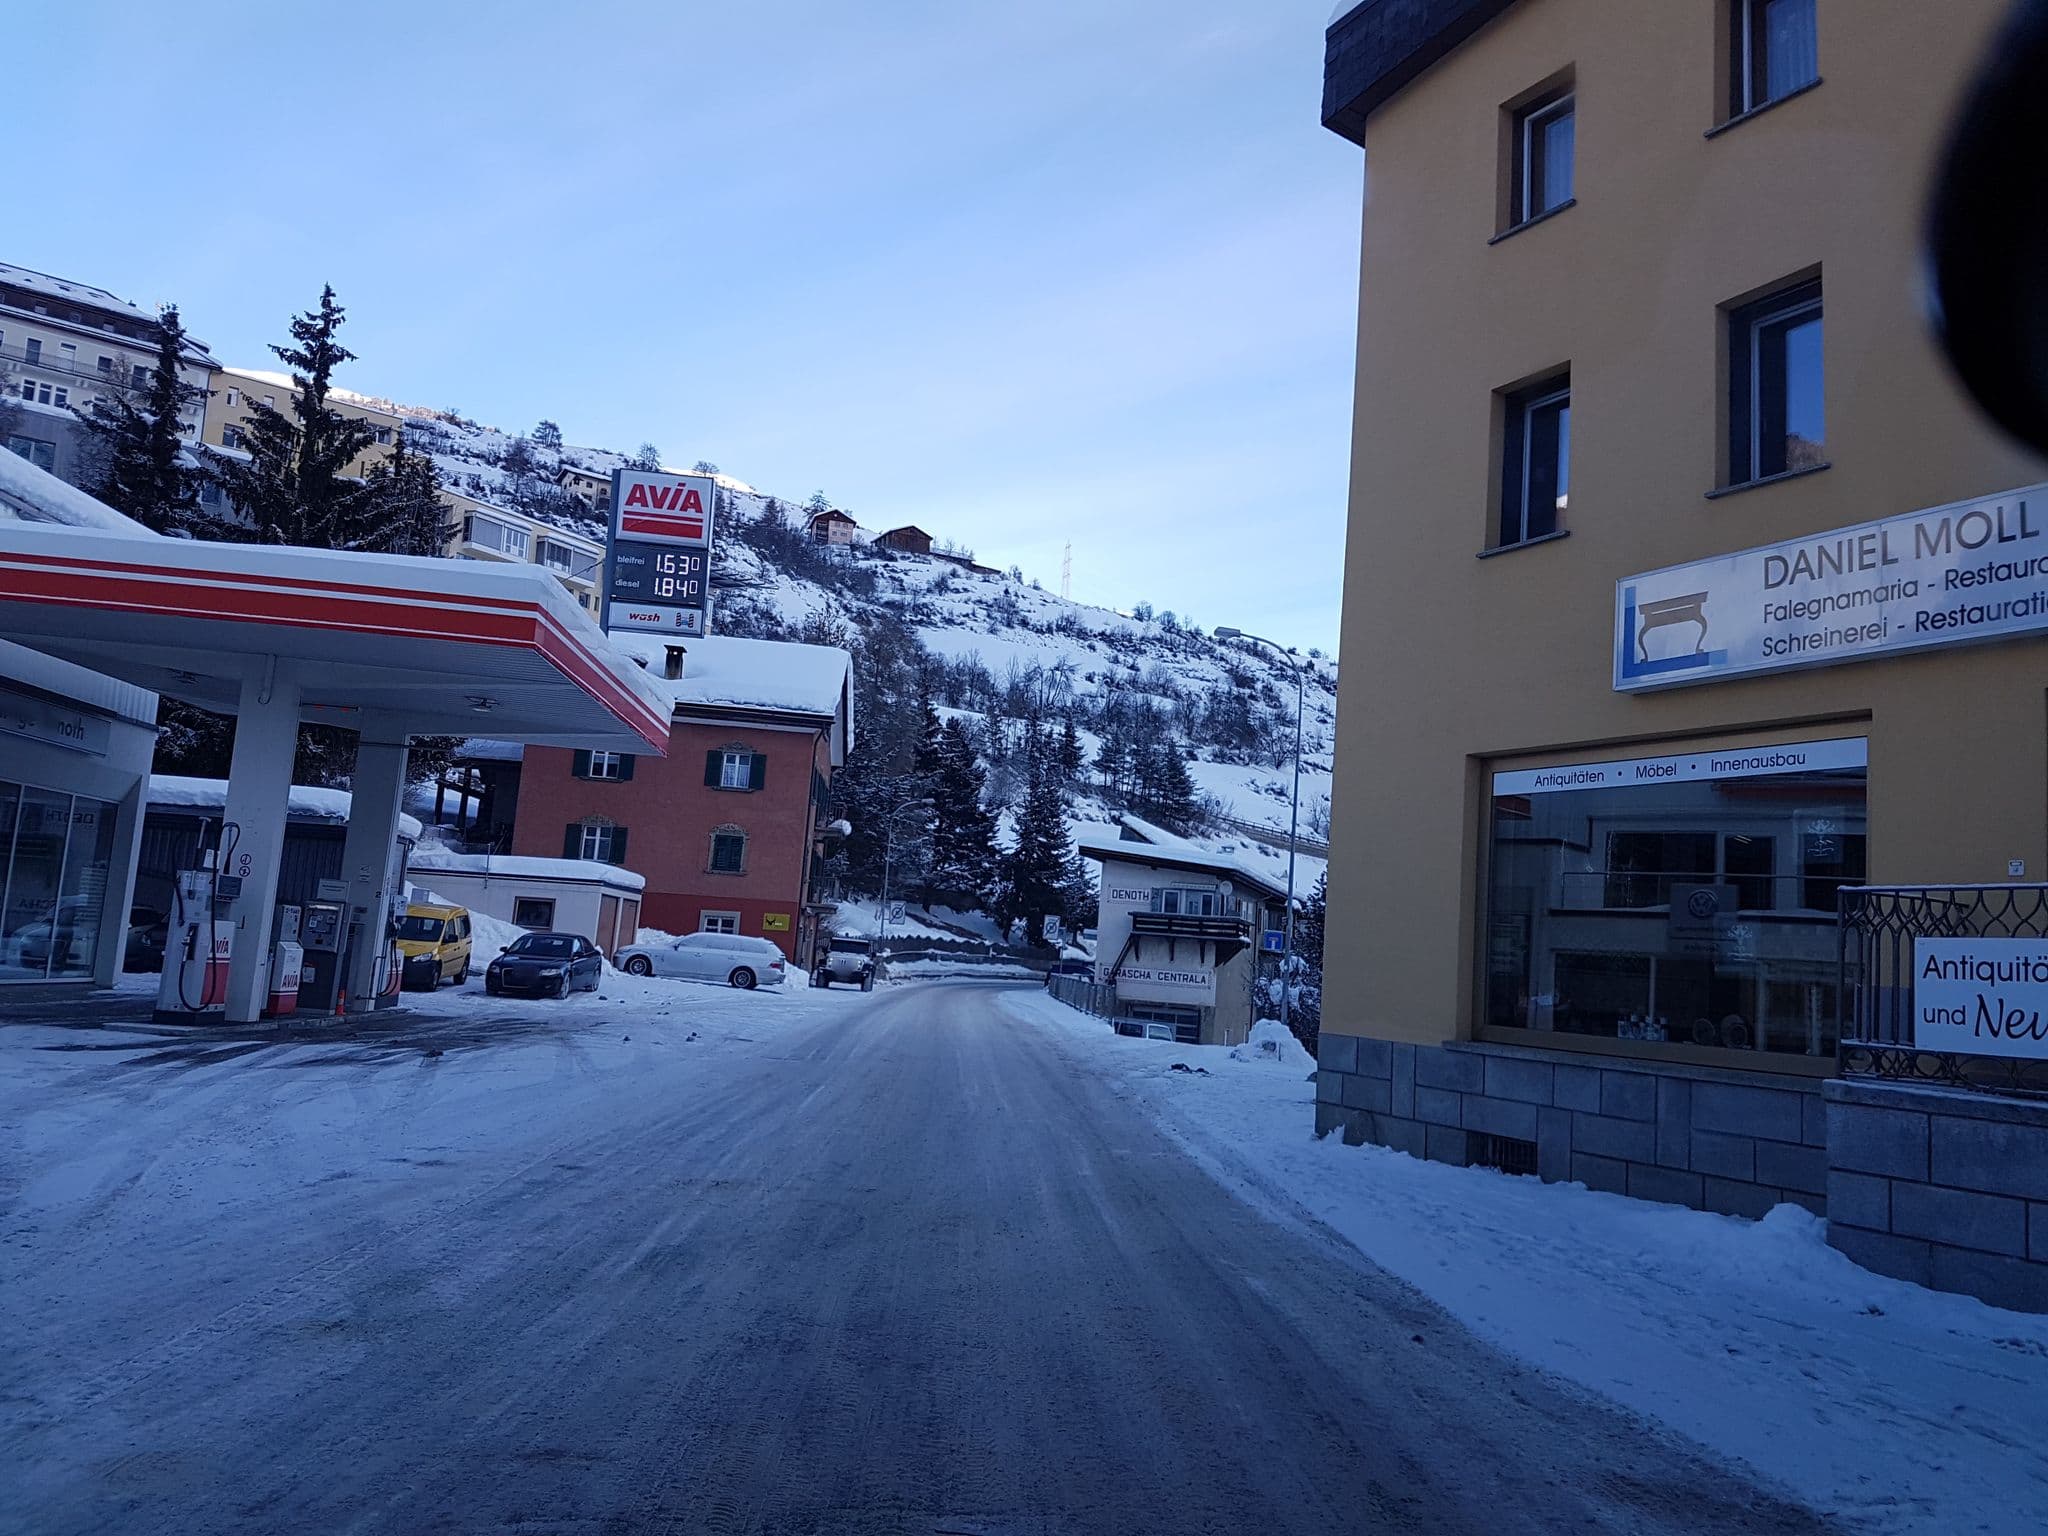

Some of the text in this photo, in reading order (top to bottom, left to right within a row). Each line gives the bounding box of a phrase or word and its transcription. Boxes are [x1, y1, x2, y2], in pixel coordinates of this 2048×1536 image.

[1764, 500, 2040, 591] DANIEL MOLL
[617, 555, 645, 565] bleifrei
[615, 579, 640, 588] diesel
[1763, 576, 1919, 625] Falegnamaria
[1761, 617, 1888, 658] Schreinerei
[1534, 751, 1806, 790] Antiquitäten Möbel Innenausbau
[1112, 889, 1149, 900] DENOTH
[1157, 971, 1207, 985] CENTRALA
[1923, 1005, 1966, 1025] und
